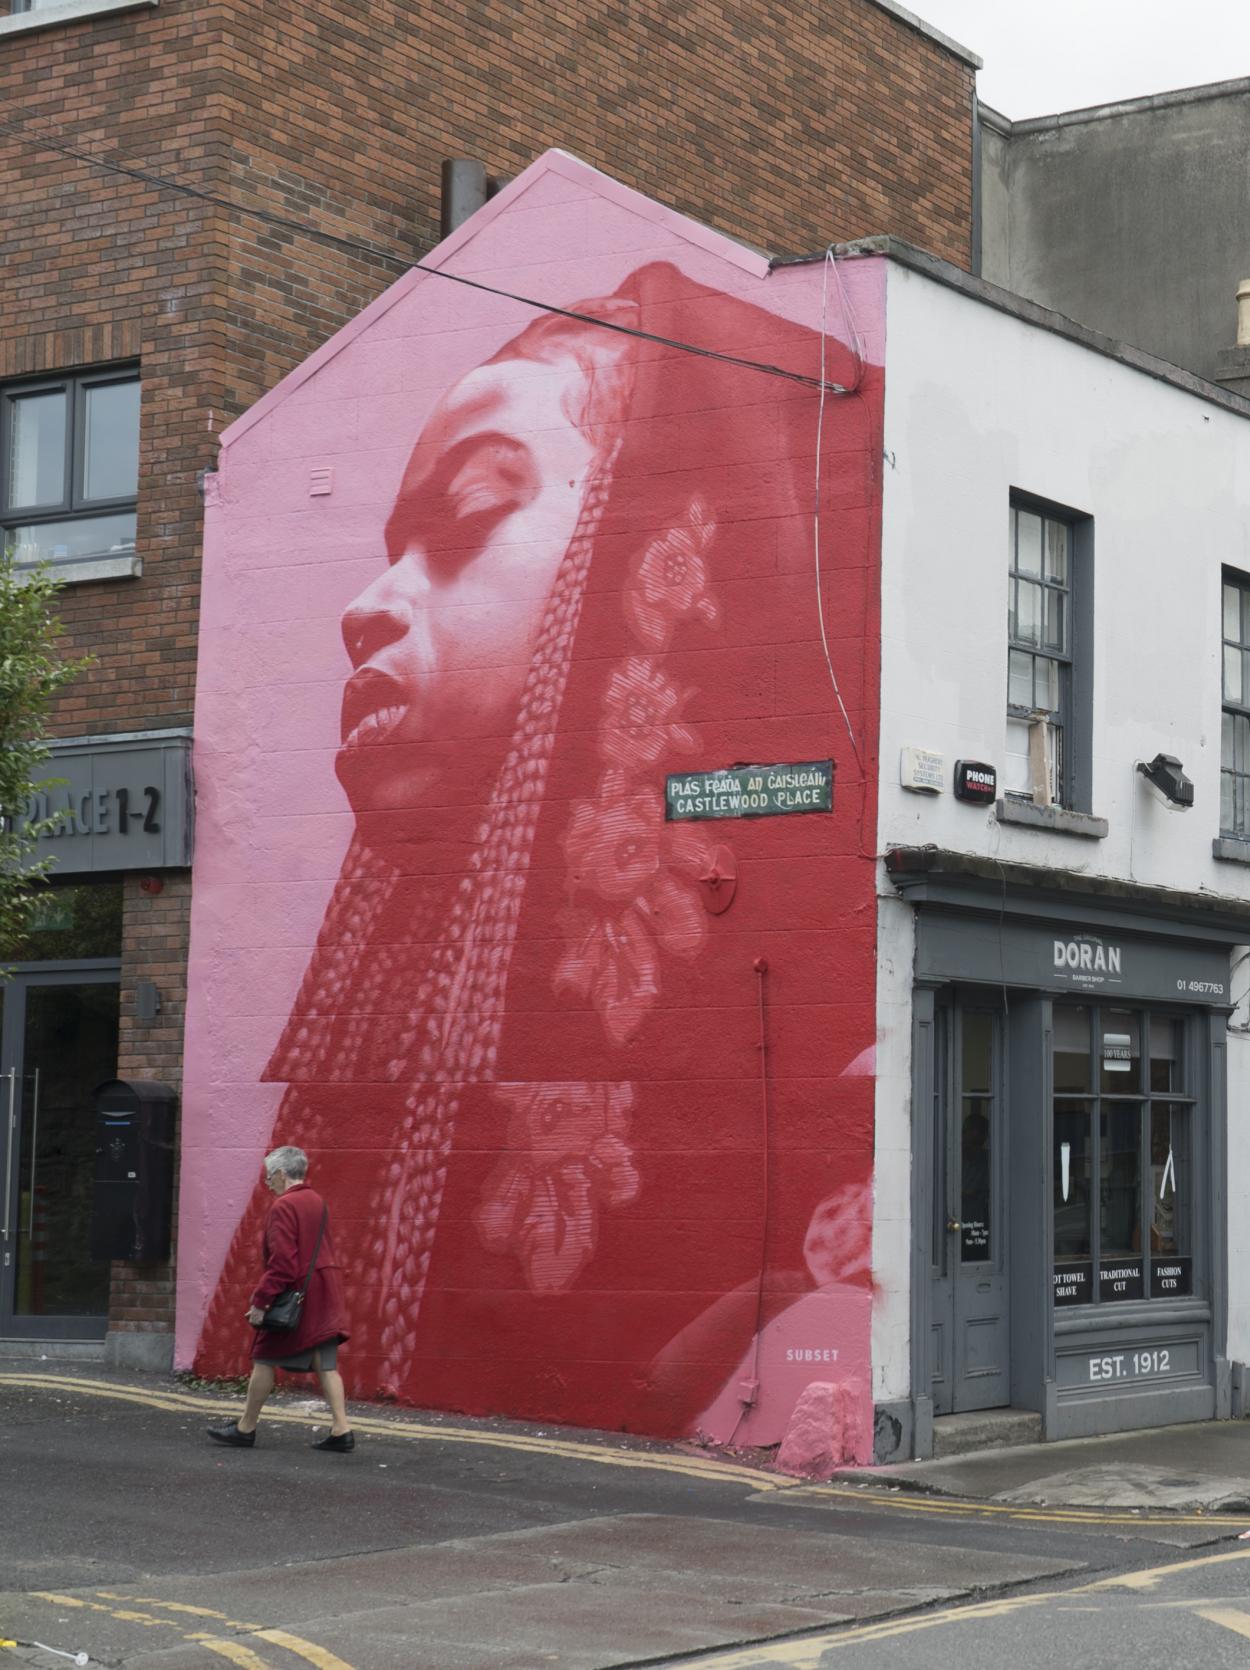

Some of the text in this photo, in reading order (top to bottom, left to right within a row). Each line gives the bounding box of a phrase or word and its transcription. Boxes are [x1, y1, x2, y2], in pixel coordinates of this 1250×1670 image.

[966, 770, 994, 786] PHONE
[677, 789, 820, 813] CASTLEWOOD PLACE
[116, 786, 161, 834] 1-2
[1054, 940, 1121, 974] DORAN
[1177, 979, 1224, 994] 01 4967763
[1053, 1272, 1086, 1284] OT TOWEL
[1100, 1268, 1140, 1281] TRADITIONAL
[1157, 1266, 1182, 1277] FASHION
[1113, 1281, 1127, 1292] CUT
[1161, 1279, 1177, 1289] CUTS
[1056, 1286, 1077, 1297] SHAVE
[786, 1349, 839, 1361] SUBSET
[1089, 1350, 1170, 1380] EST. 1912
